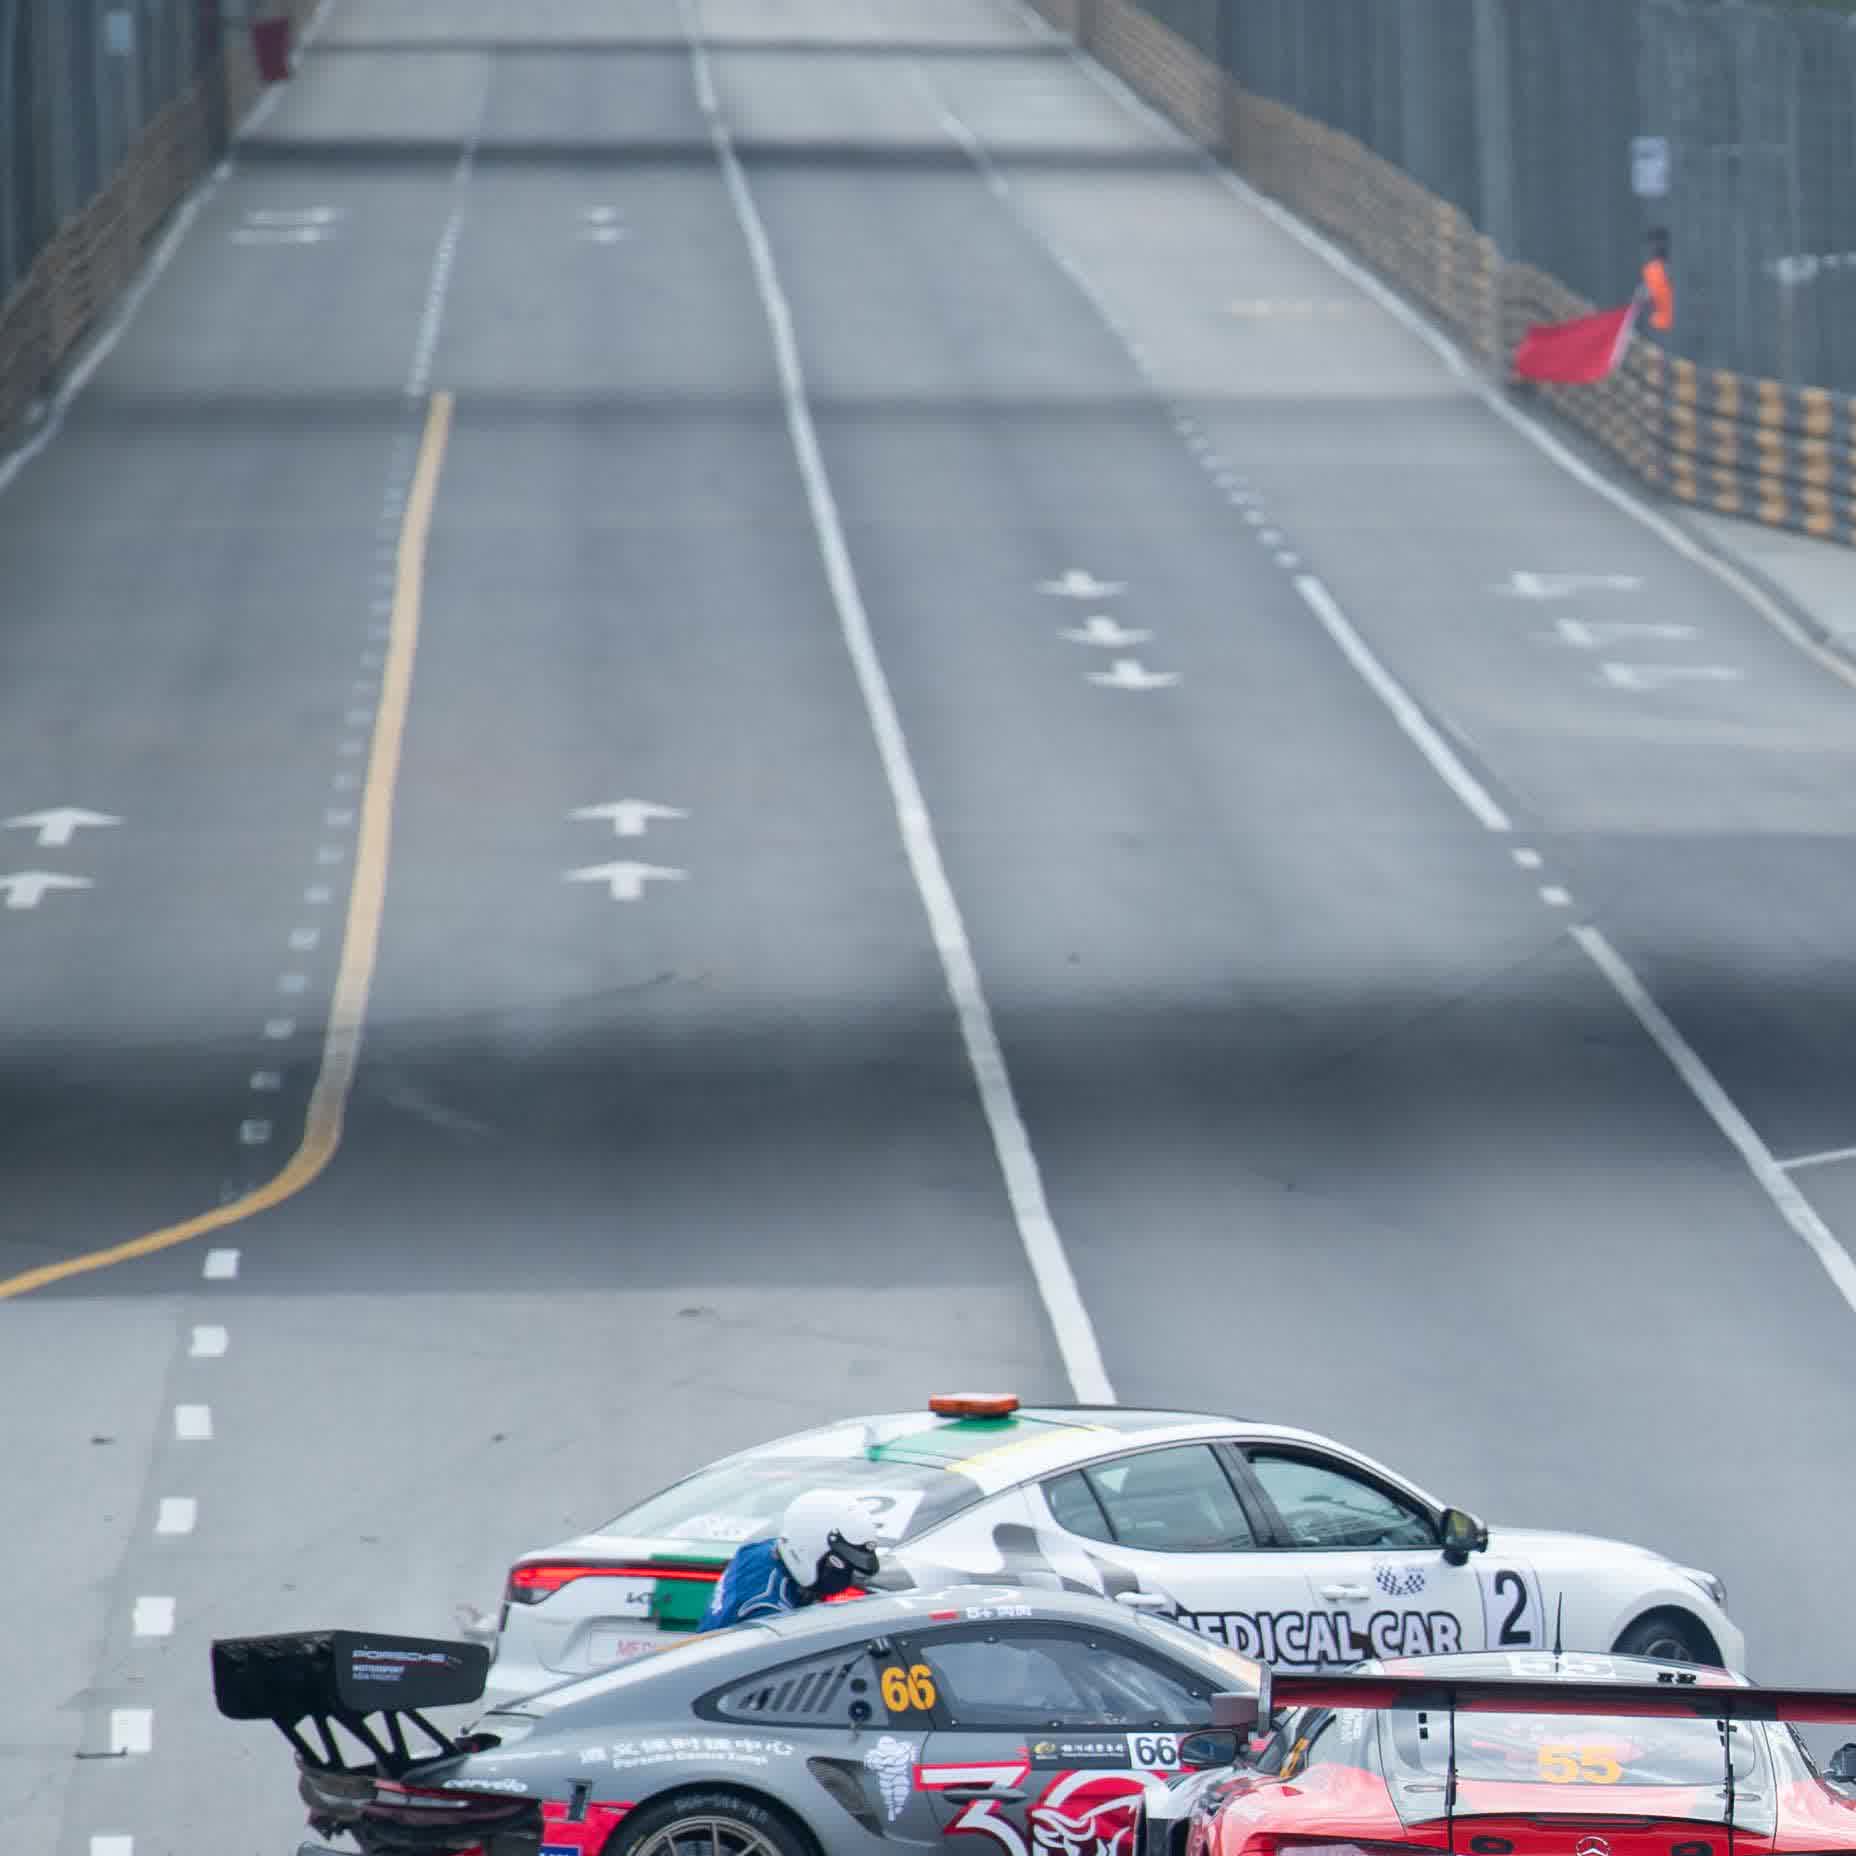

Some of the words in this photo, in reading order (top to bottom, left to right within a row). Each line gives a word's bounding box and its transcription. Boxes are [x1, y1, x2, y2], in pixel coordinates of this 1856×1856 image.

[1494, 1570, 1532, 1648] 2
[1367, 1610, 1463, 1655] CAR
[881, 1664, 936, 1712] 66
[1135, 1737, 1177, 1766] 66
[1538, 1744, 1622, 1783] 55
